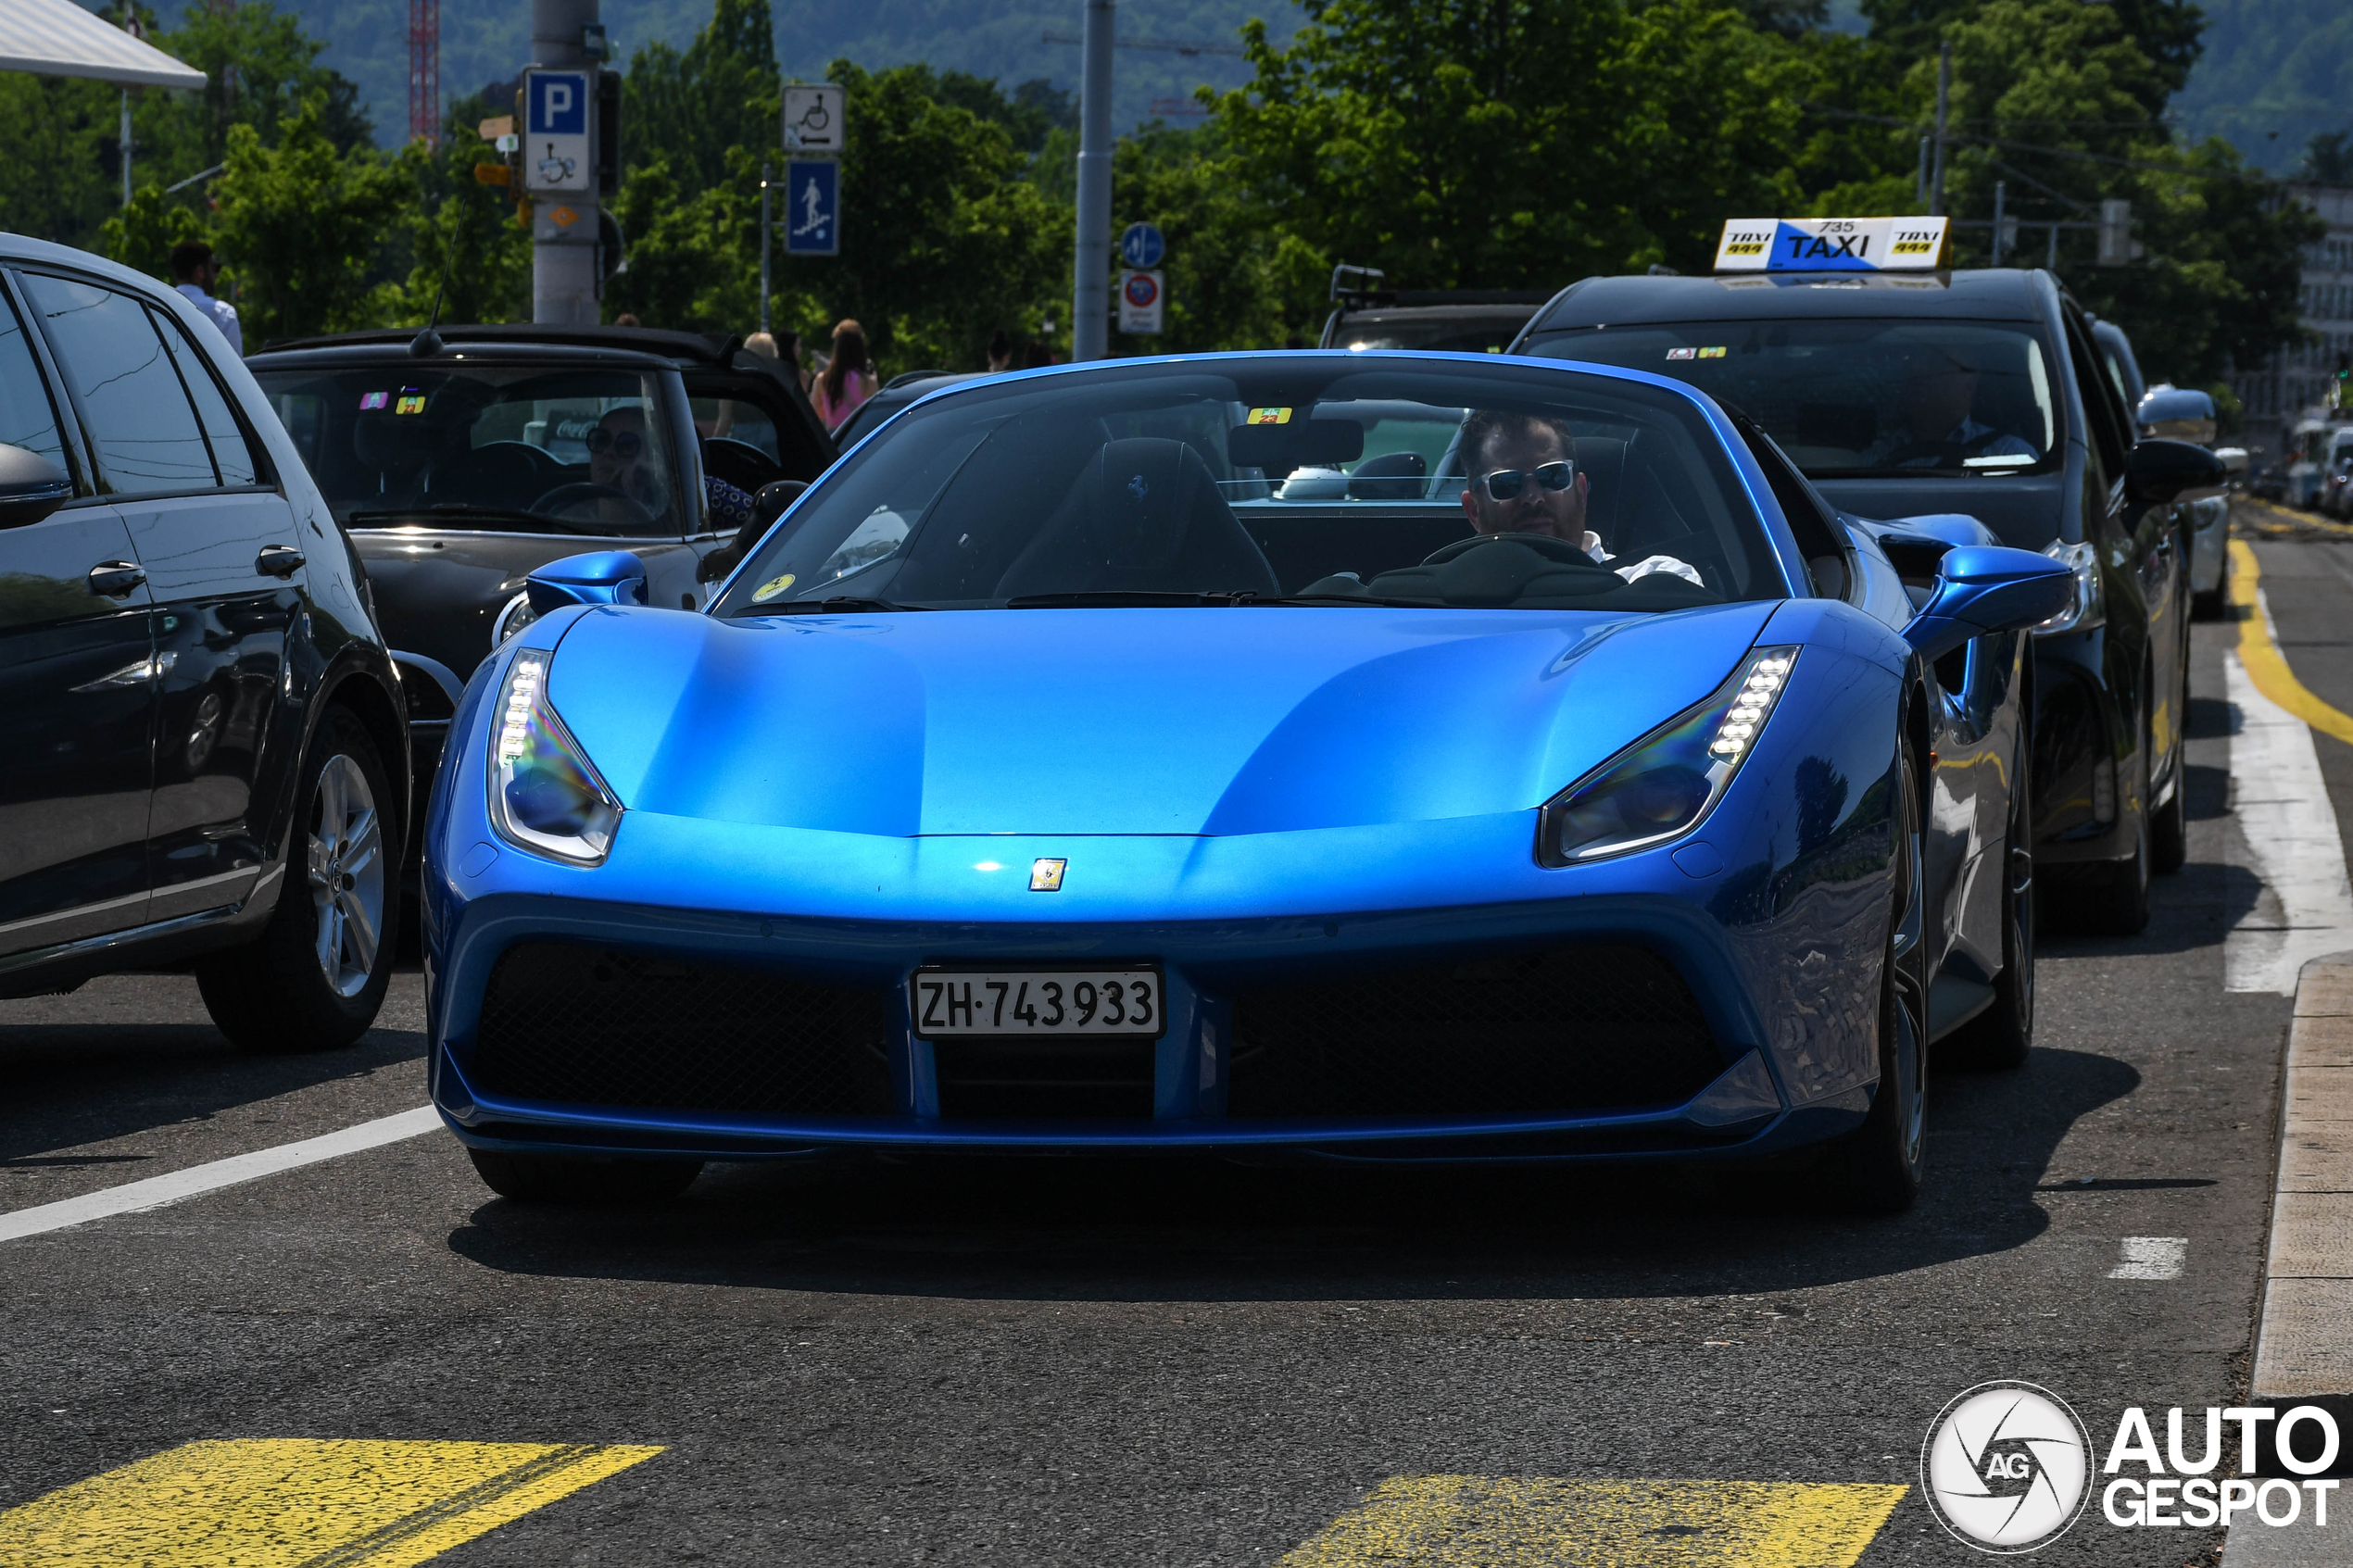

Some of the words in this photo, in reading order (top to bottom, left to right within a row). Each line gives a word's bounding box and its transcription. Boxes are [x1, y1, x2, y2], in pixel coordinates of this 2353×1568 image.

[545, 83, 572, 128] P
[1818, 221, 1855, 232] 735
[1728, 232, 1771, 242] TAXI
[1894, 232, 1939, 241] TAXI
[1788, 235, 1870, 258] TAXI
[1259, 414, 1278, 423] 23
